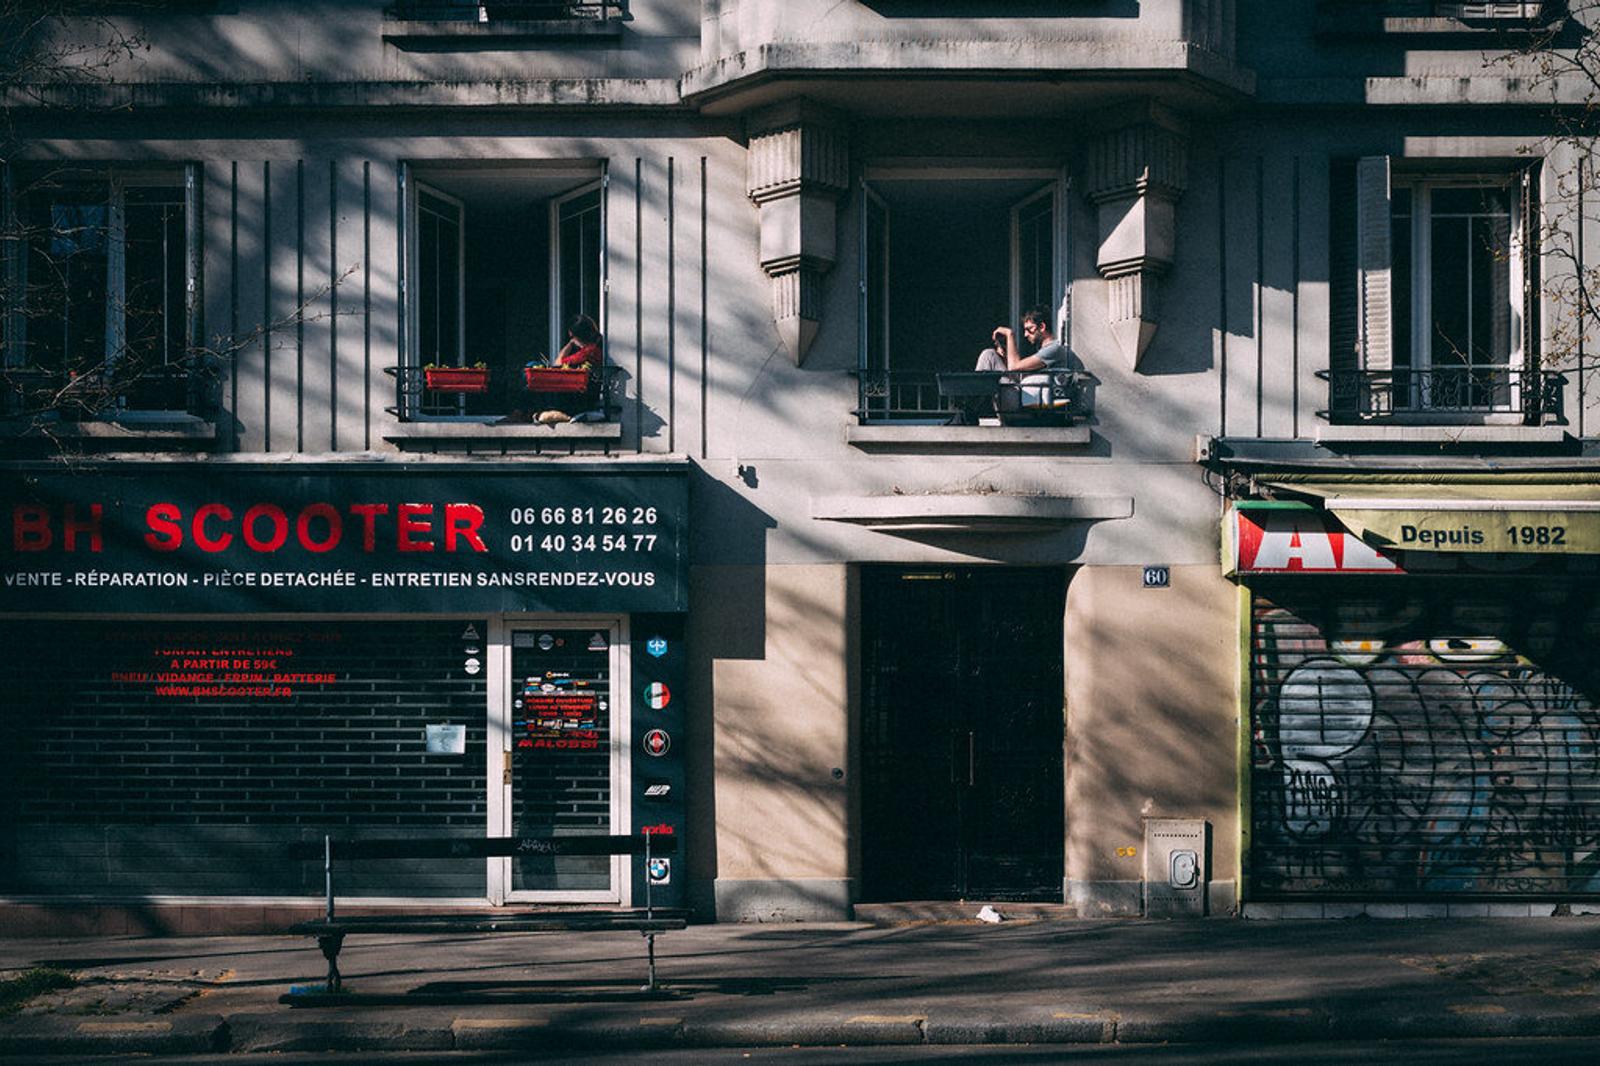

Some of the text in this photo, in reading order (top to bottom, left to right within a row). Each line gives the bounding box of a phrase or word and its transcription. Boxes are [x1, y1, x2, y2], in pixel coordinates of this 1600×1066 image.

[510, 506, 657, 525] 06 66 81 26 26
[14, 503, 489, 553] BH SCOOTER
[1401, 525, 1567, 548] Depuis 1982
[510, 533, 657, 552] 01 40 34 54 77
[5, 573, 61, 587] VENTE
[203, 569, 256, 587] PIÈCE
[260, 569, 356, 587] DETACHÉE
[372, 573, 471, 588] ENTRETIEN
[1145, 568, 1168, 585] 60
[182, 659, 229, 669] PARTIR
[232, 659, 250, 669] DE
[156, 672, 214, 682] VIDANGE
[272, 673, 336, 683] BATTERIE
